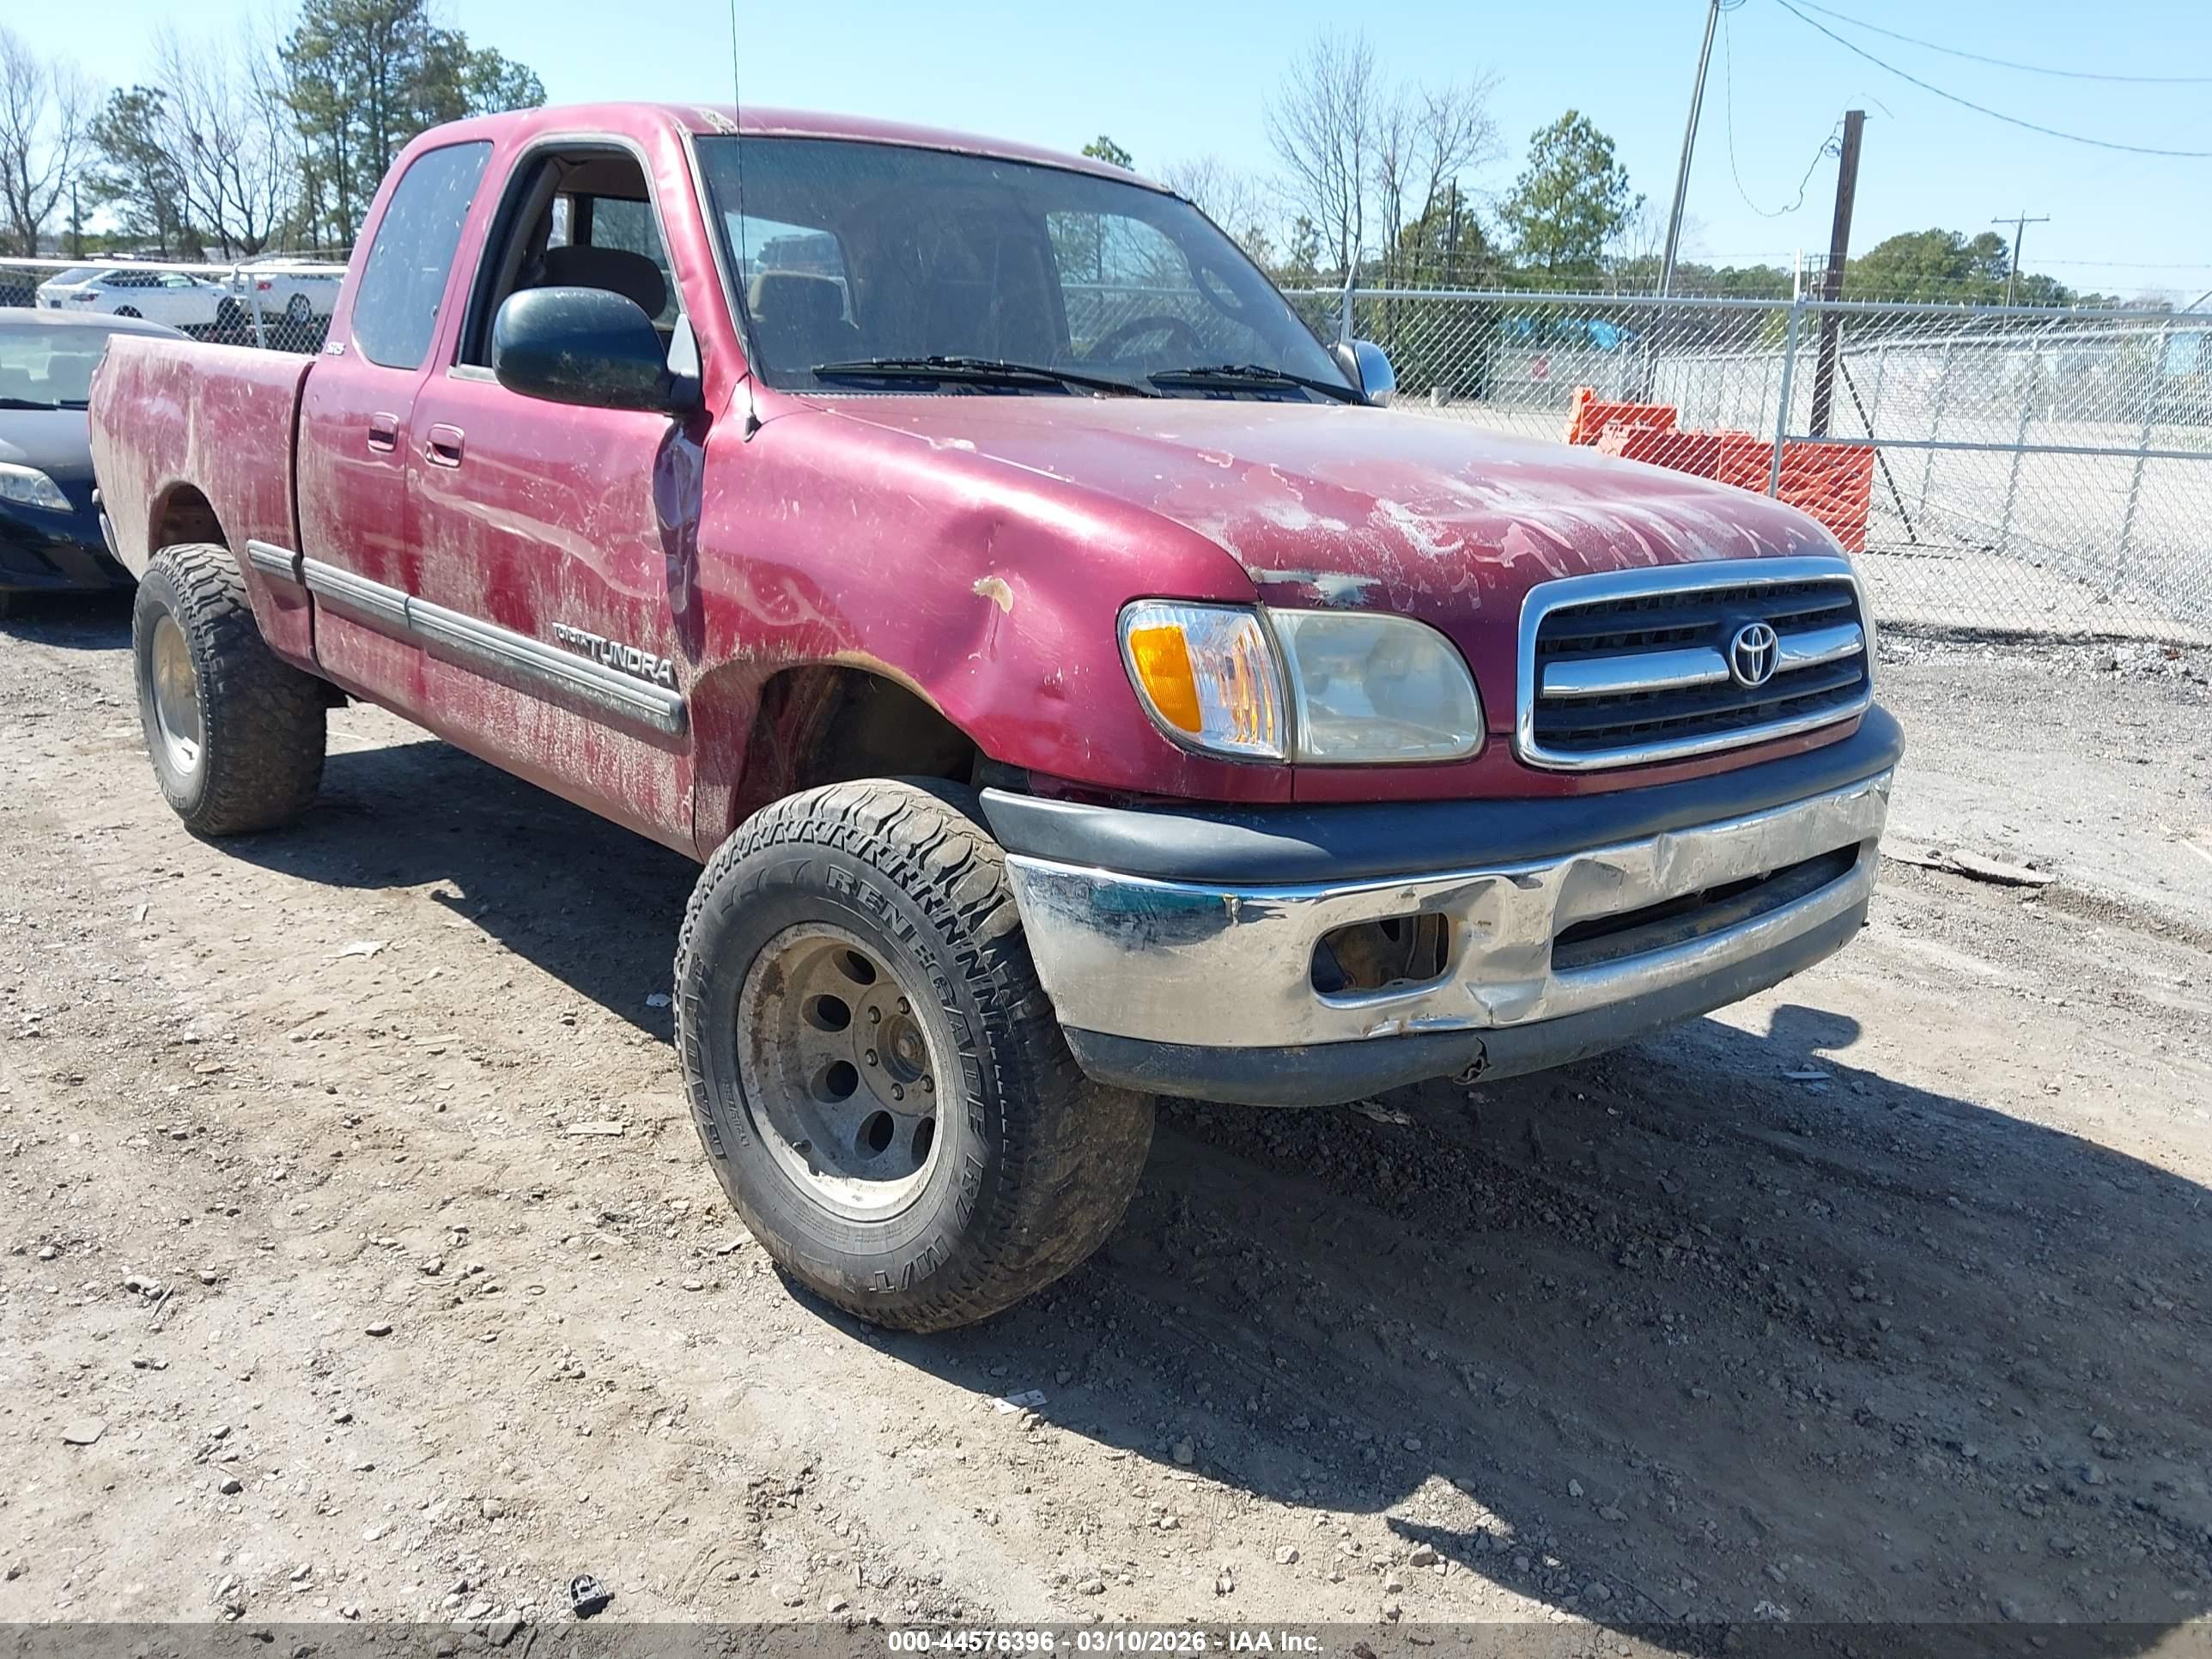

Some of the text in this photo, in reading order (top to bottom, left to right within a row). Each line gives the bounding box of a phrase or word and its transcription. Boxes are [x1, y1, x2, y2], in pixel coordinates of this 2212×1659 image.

[587, 633, 672, 684] TUNDRA
[827, 864, 986, 1136] RENEGADE
[868, 1235, 951, 1294] M/T
